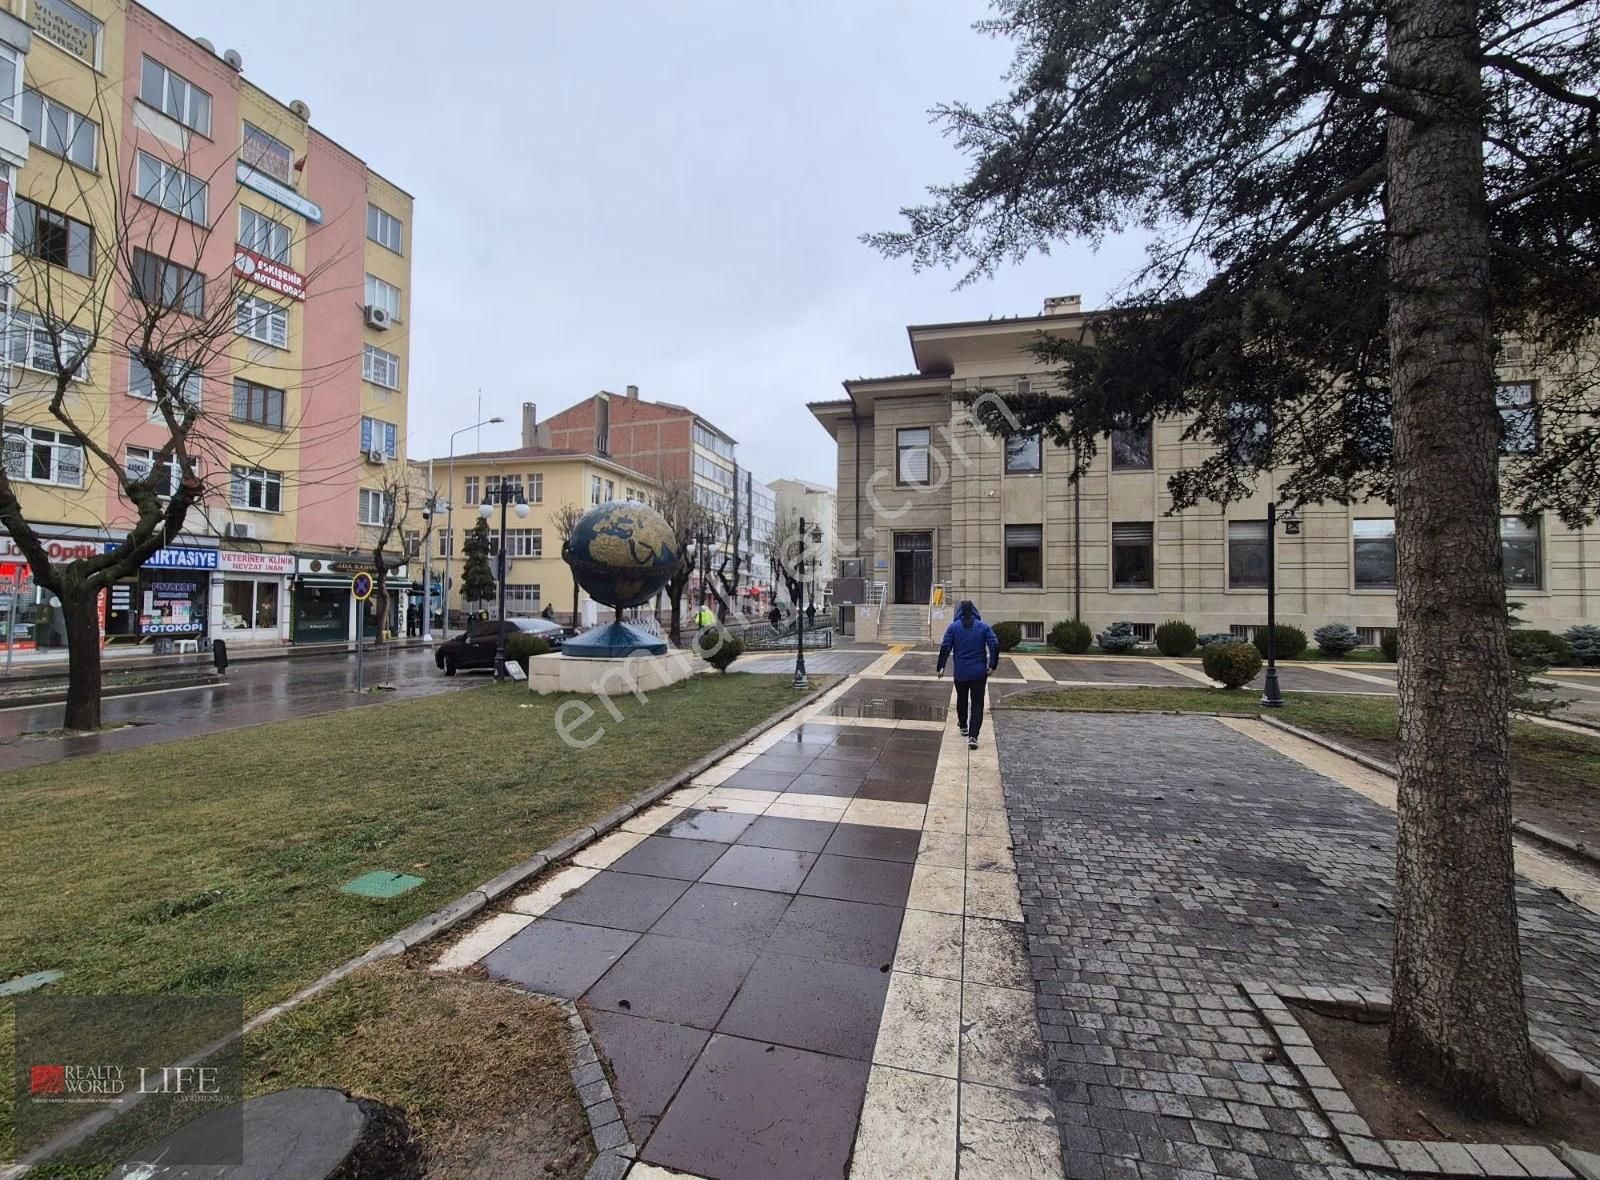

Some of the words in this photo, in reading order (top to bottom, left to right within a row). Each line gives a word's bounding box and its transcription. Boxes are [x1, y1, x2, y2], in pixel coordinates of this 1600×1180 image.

[254, 272, 282, 290] NOTER
[49, 543, 96, 560] Optik
[232, 562, 262, 570] NEVZAT
